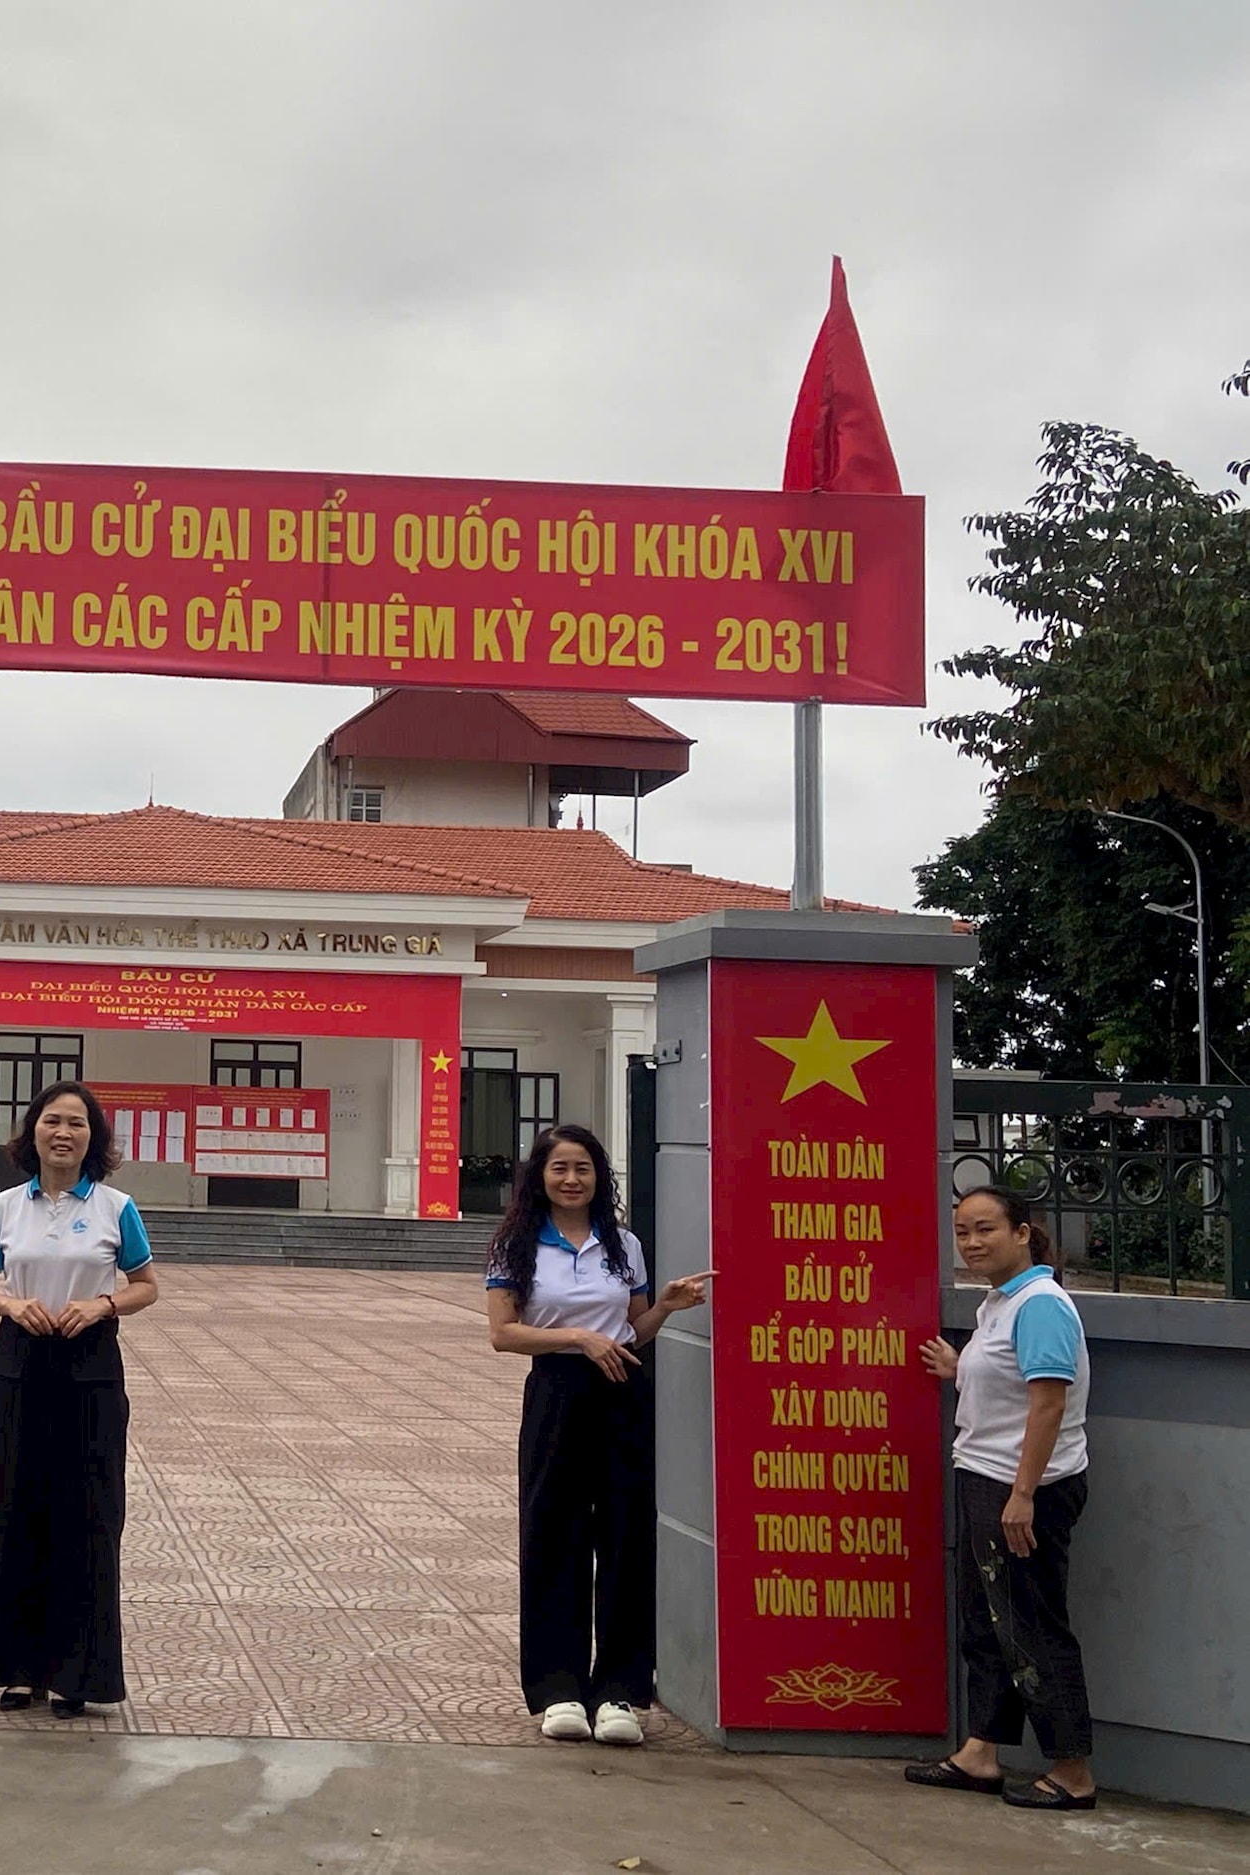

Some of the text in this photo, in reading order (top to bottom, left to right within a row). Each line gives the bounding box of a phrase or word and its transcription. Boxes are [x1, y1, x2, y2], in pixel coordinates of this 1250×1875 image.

[92, 481, 161, 557] CỬ
[170, 506, 250, 572] ĐẠI
[268, 489, 376, 565] BIỂU
[394, 498, 520, 574] QUỐC
[538, 509, 616, 586] HỘI
[634, 514, 762, 580] KHÓA
[778, 529, 853, 584] XVI
[72, 583, 167, 649] CÁC
[186, 579, 281, 652] CẤP
[299, 593, 455, 670] NHIỆM
[473, 597, 534, 662] KỲ
[549, 612, 664, 668] 2026
[43, 920, 90, 945] VĂN
[97, 921, 145, 947] HÓA
[154, 919, 199, 948] THỂ
[206, 926, 270, 950] THAO
[317, 932, 397, 954] TRUNG
[207, 1010, 239, 1018] 2031
[271, 989, 307, 1000] XVI
[768, 1133, 884, 1180] TOÀN DÂN
[771, 1202, 883, 1241] THAM GIA
[785, 1251, 873, 1303] BẦU CỬ
[750, 1311, 905, 1366] ĐỂ GÓP PHẦN
[771, 1381, 887, 1436] XÂY DỰNG
[753, 1441, 909, 1495] CHÍNH QUYỀN
[754, 1514, 909, 1563] TRONG SẠCH,
[754, 1568, 817, 1617] VỮNG
[825, 1579, 895, 1626] MẠNH
